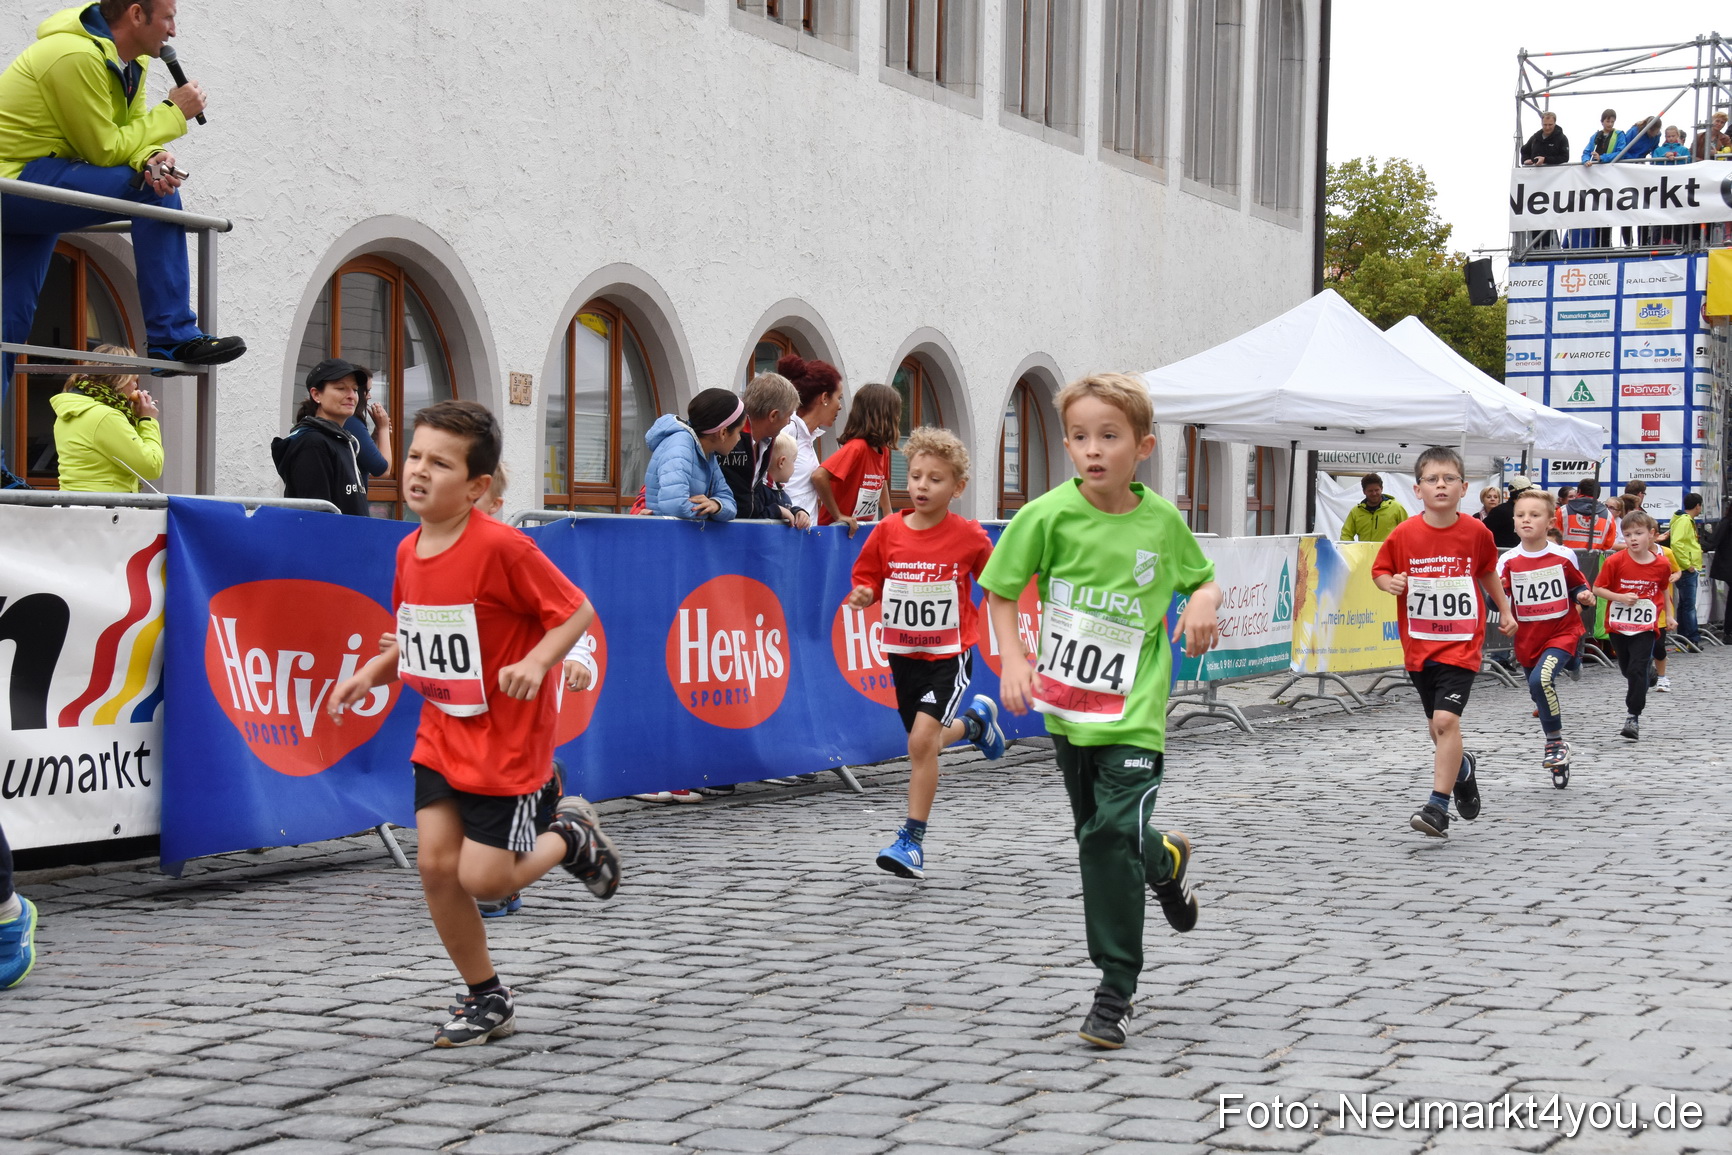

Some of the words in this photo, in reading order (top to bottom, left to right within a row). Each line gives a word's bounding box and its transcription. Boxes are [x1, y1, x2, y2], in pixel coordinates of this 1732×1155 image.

[1510, 176, 1700, 215] Neumarkt
[1559, 312, 1586, 320] Neumarkter
[1569, 351, 1611, 359] VARIOTEC
[1641, 428, 1659, 437] Braun
[1552, 460, 1590, 471] swn
[1409, 556, 1456, 565] Neumarkter
[1410, 565, 1446, 573] Stadtlauf
[912, 584, 952, 594] BOCK
[1515, 578, 1563, 603] 7420
[1075, 586, 1143, 618] JURA
[1414, 593, 1471, 616] 7196
[416, 609, 464, 623] BOCK
[889, 598, 952, 627] 7067
[1615, 607, 1653, 623] 7126
[1078, 617, 1134, 645] BOCK
[1432, 622, 1453, 632] Paul
[899, 633, 942, 646] Mariano
[400, 629, 471, 673] 7140
[679, 608, 784, 697] Hervis
[1049, 632, 1125, 691] 7404
[420, 682, 451, 701] Julian
[691, 688, 749, 708] SPORTS
[1042, 683, 1108, 713] ELIAS
[244, 721, 299, 746] SPORTS
[2, 741, 151, 800] umarkt
